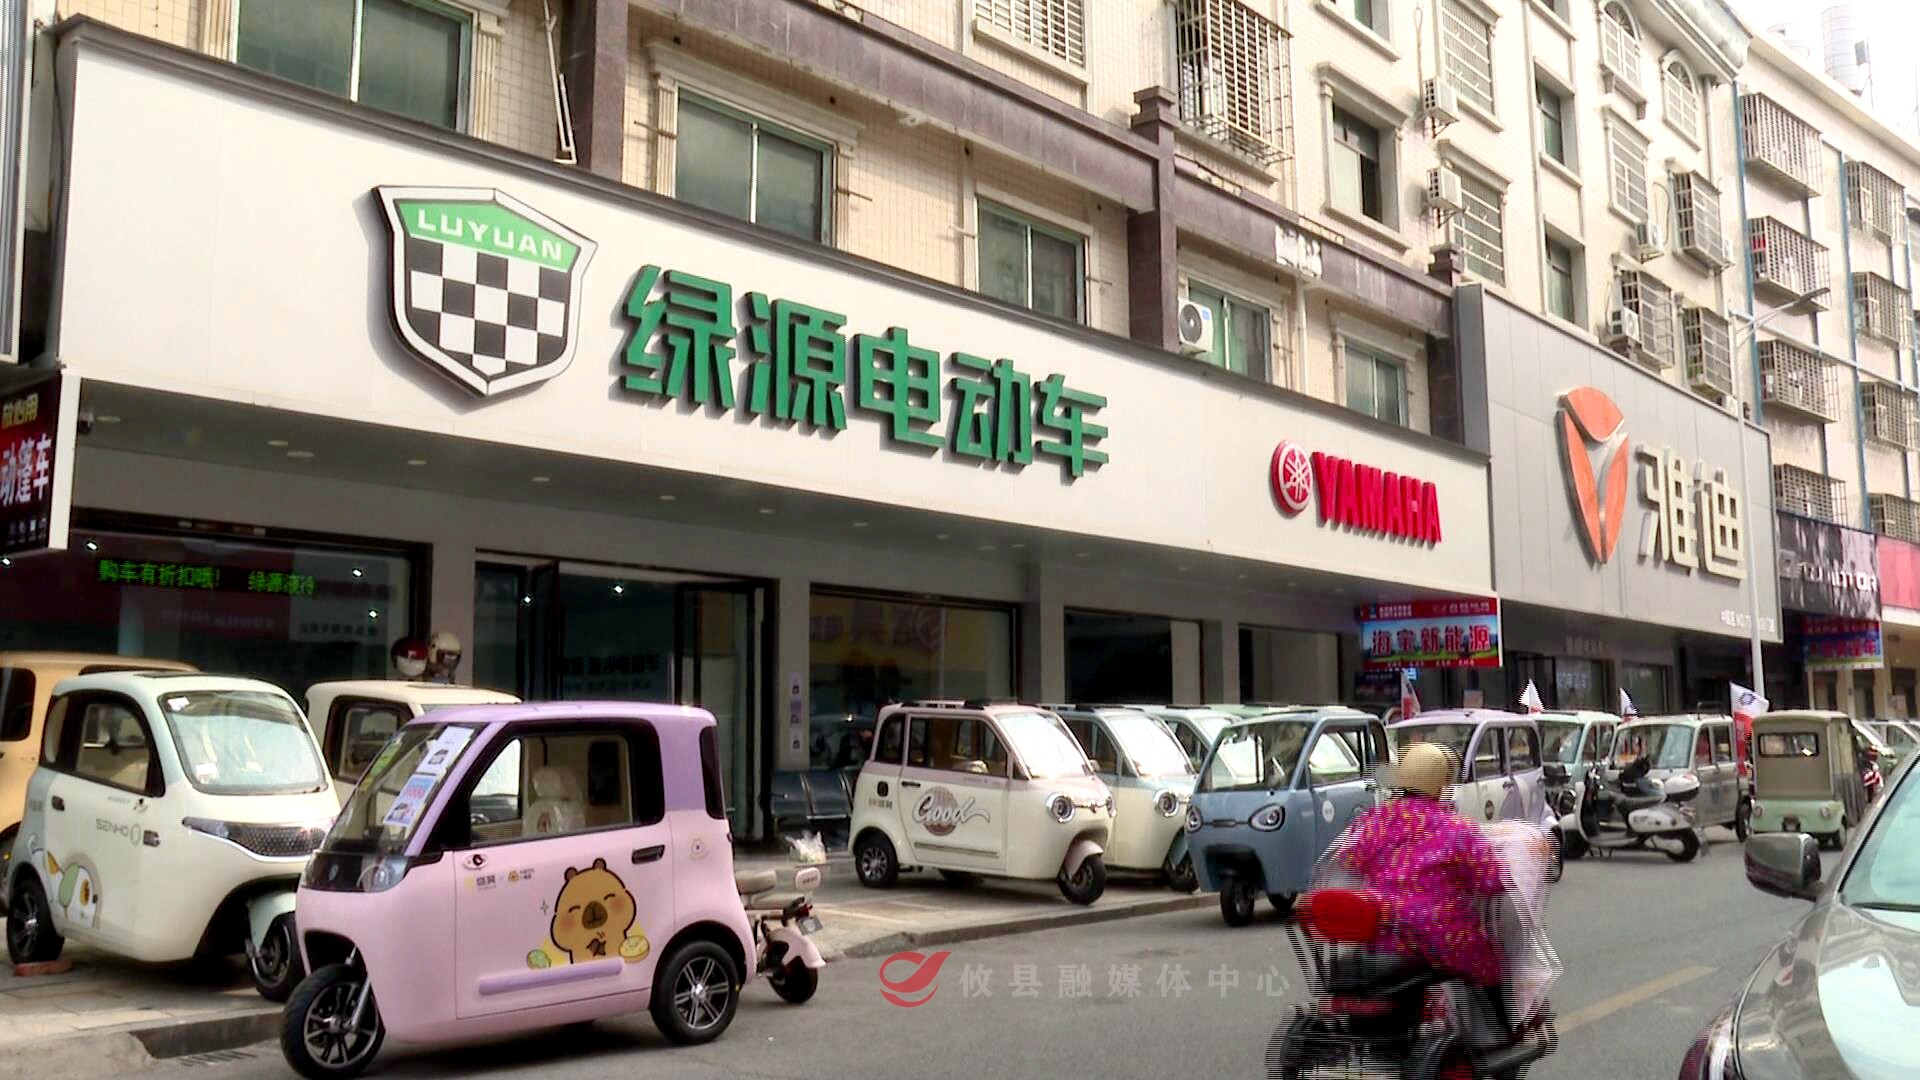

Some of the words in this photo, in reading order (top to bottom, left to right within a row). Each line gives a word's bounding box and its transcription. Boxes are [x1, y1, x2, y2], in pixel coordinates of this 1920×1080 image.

[417, 208, 562, 262] LUYUAN
[621, 265, 1108, 479] 绿源电动车
[1312, 452, 1442, 544] YAMAHA
[1634, 445, 1748, 580] 雅迪
[912, 791, 991, 825] Good
